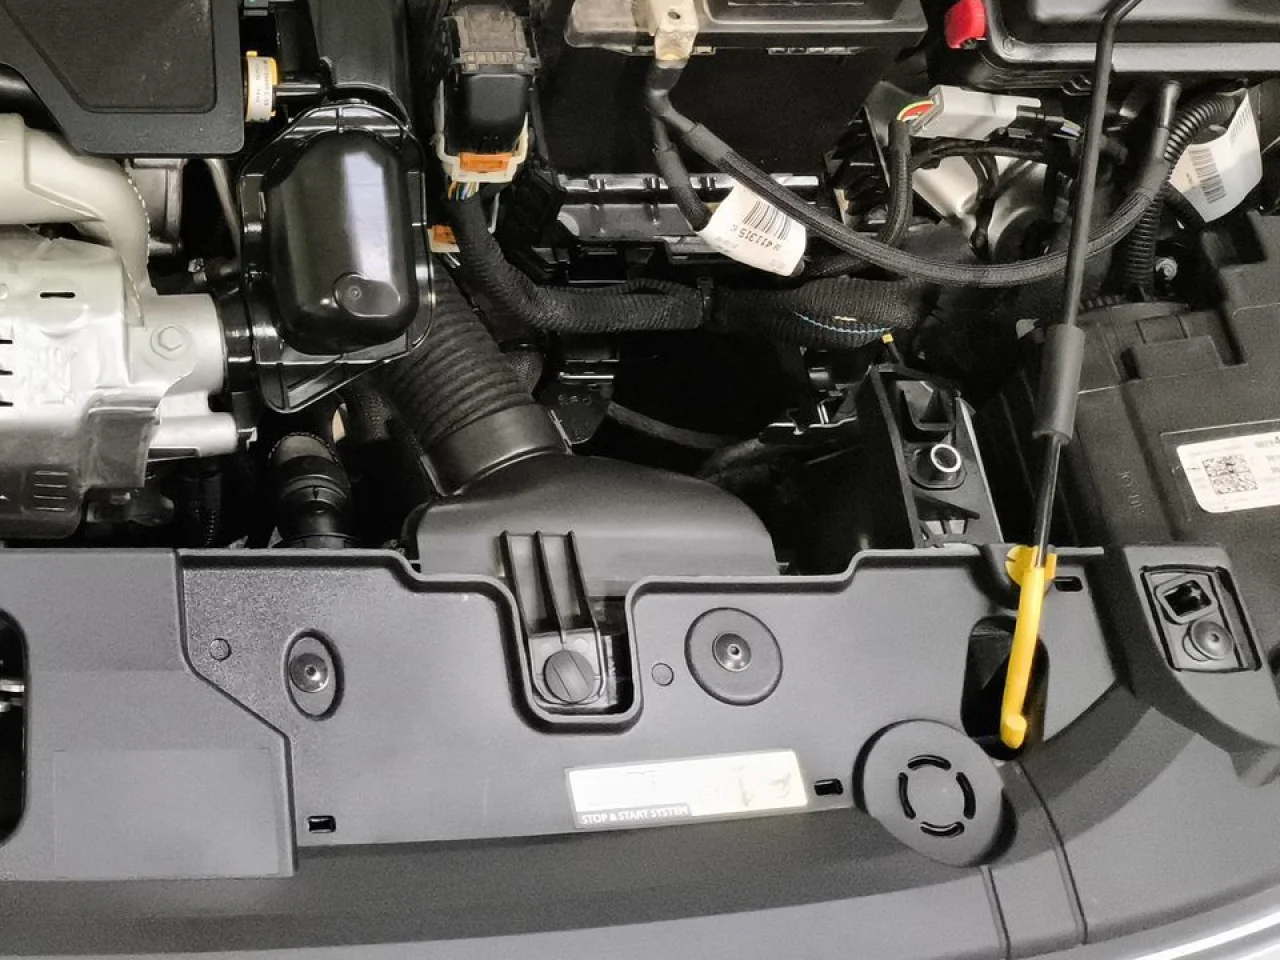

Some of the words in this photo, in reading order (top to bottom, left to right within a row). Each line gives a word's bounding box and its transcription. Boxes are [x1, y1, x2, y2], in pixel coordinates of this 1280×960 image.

[581, 813, 607, 824] STOP
[618, 809, 648, 821] START
[650, 805, 689, 819] SYSTEM
